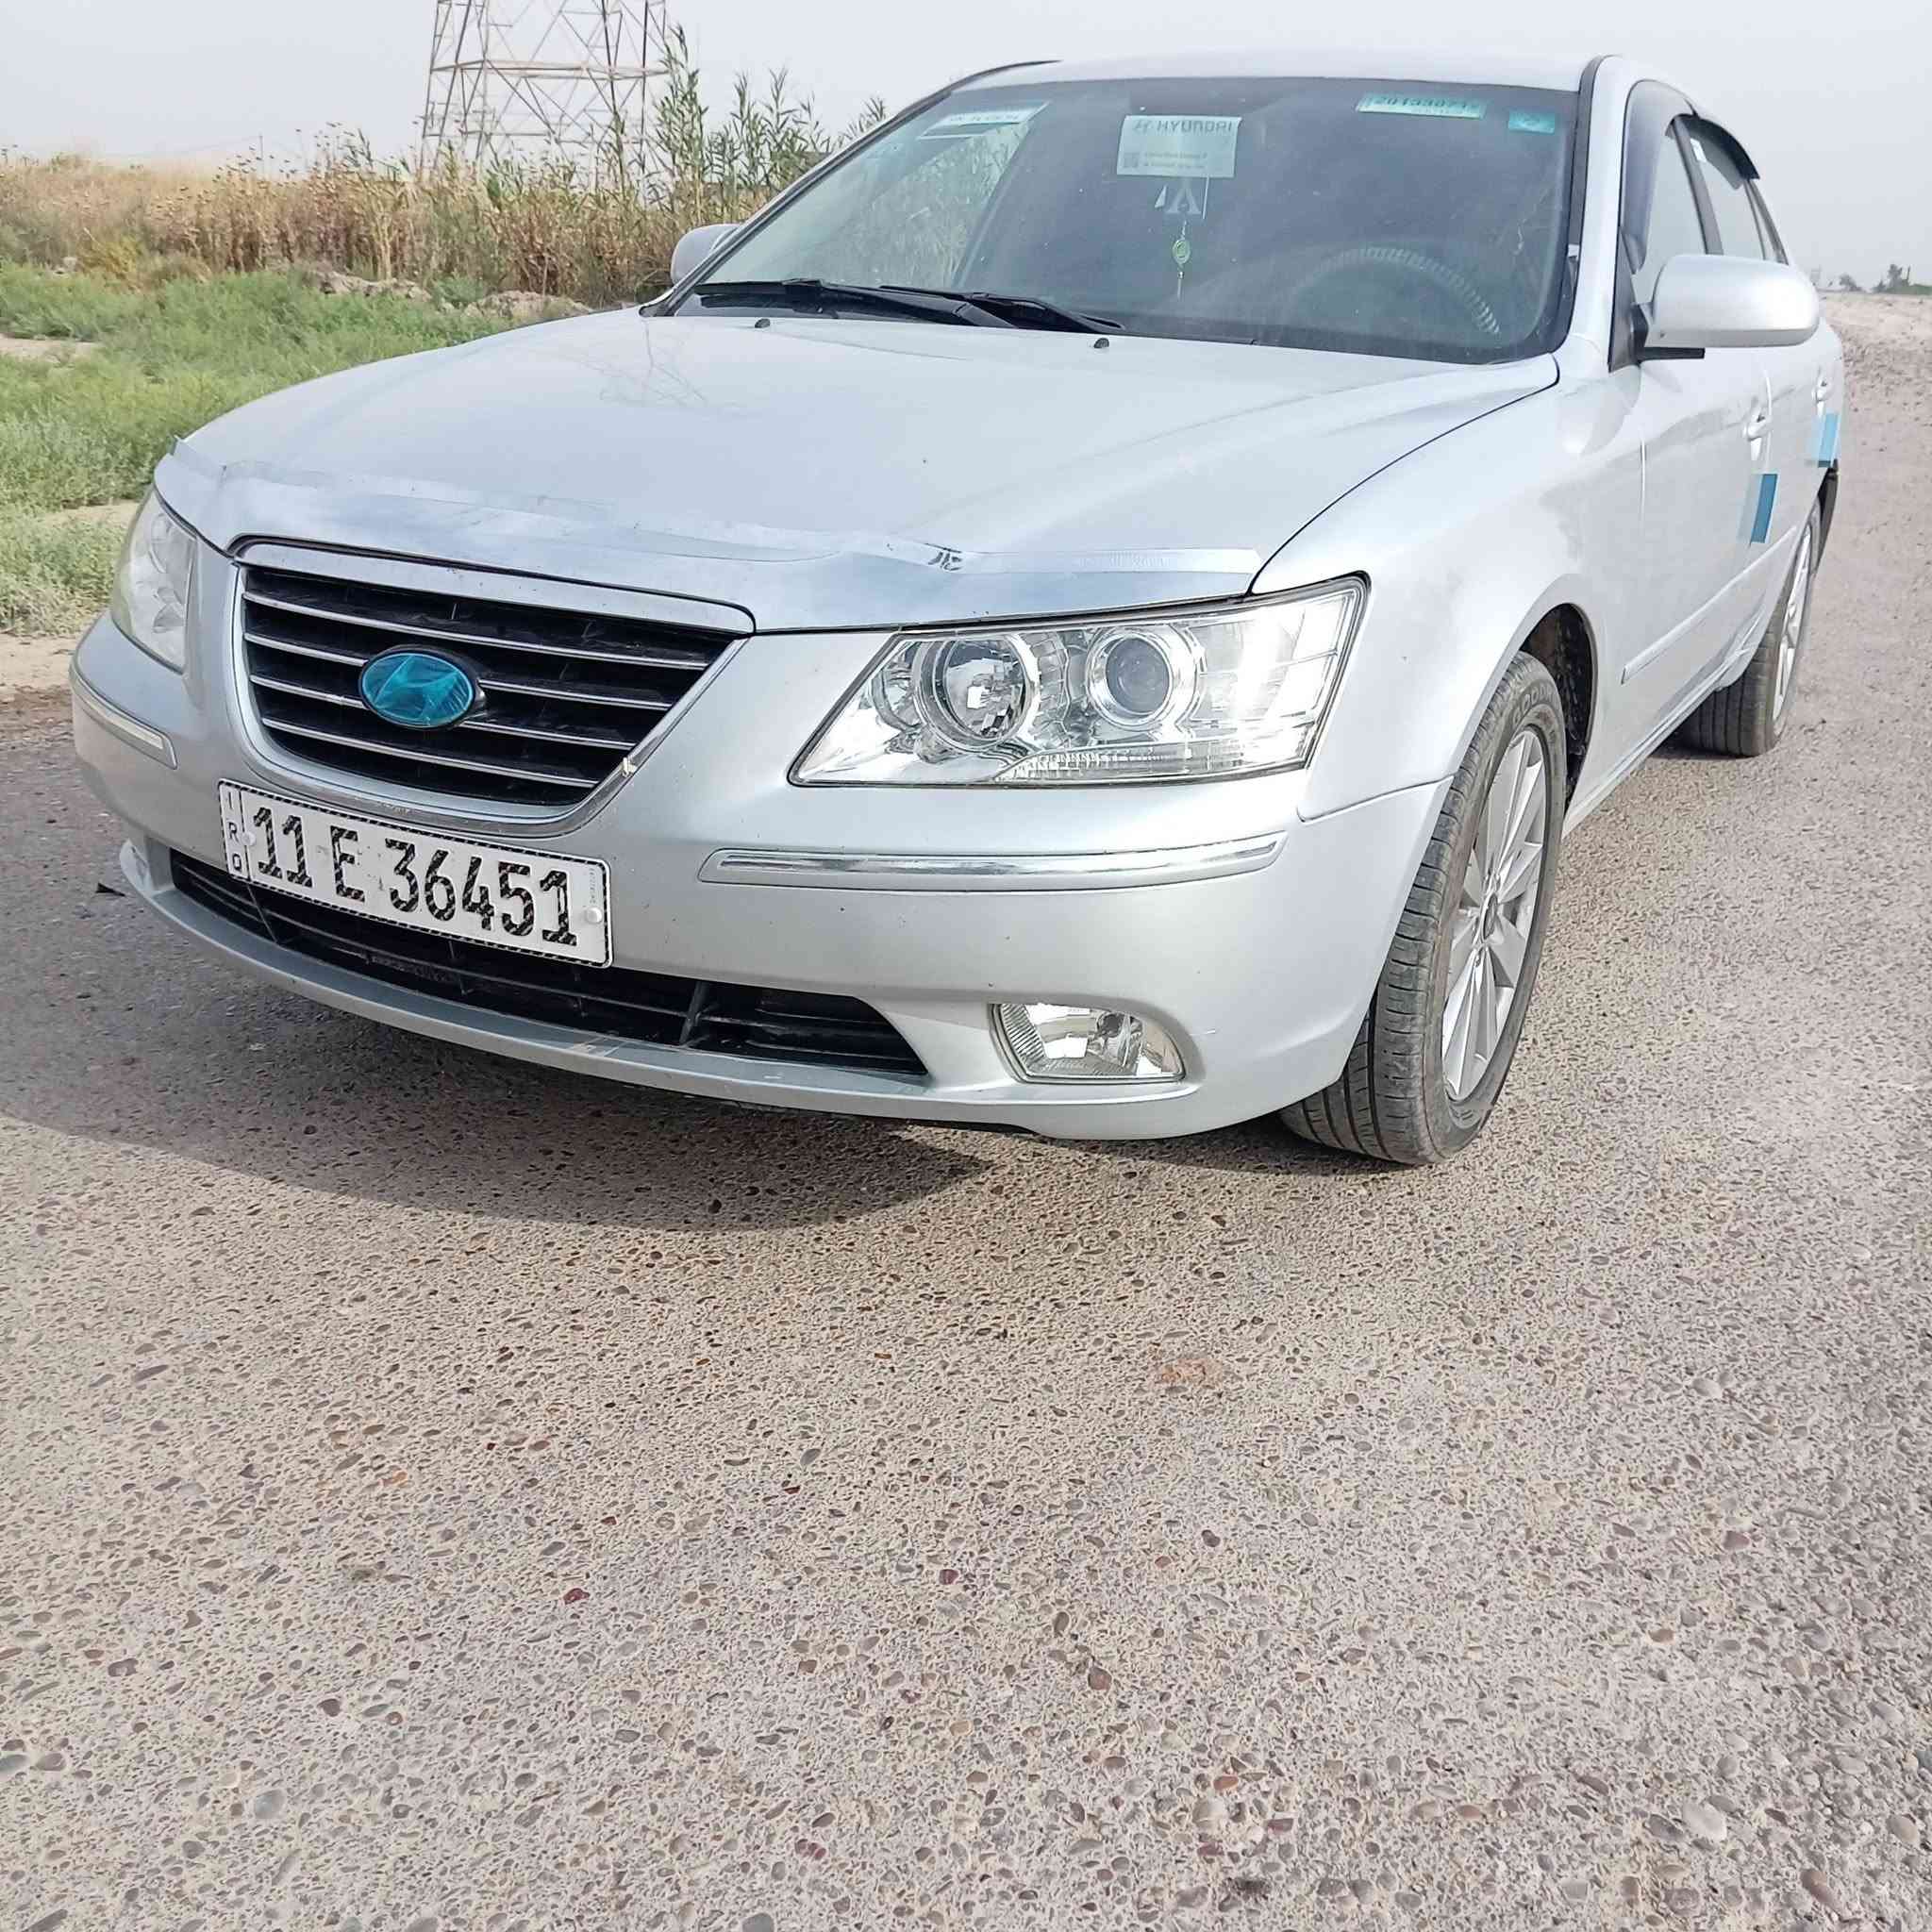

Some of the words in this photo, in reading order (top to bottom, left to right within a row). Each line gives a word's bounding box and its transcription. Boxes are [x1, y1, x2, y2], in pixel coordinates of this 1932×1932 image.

[1157, 119, 1232, 133] HYUNDAI
[253, 807, 313, 889] 11
[329, 824, 366, 903] E
[385, 838, 577, 947] 36451
